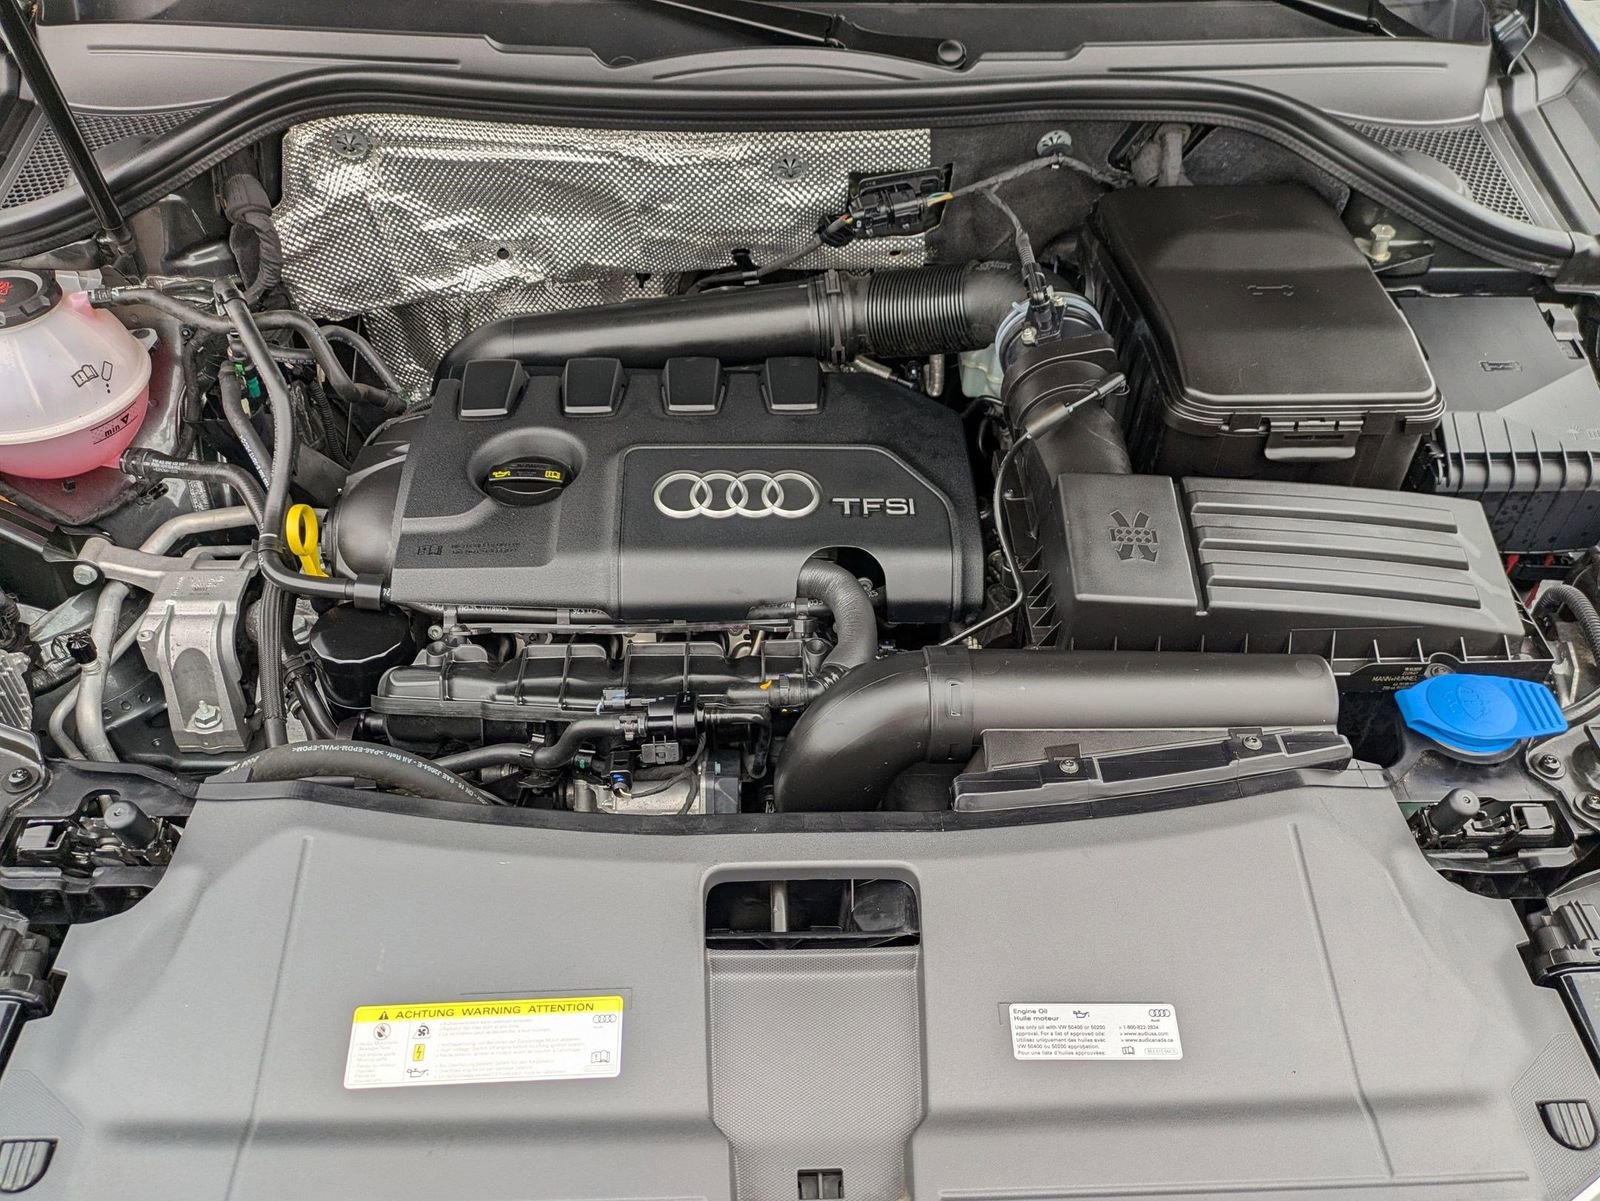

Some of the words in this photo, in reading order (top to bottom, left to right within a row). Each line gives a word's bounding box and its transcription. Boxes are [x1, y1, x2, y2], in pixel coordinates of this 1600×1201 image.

[104, 424, 120, 438] min
[832, 496, 916, 518] TFSI
[396, 1008, 454, 1019] ACHTUNG
[462, 1006, 521, 1016] WARNING
[528, 1002, 594, 1014] ATTENTION
